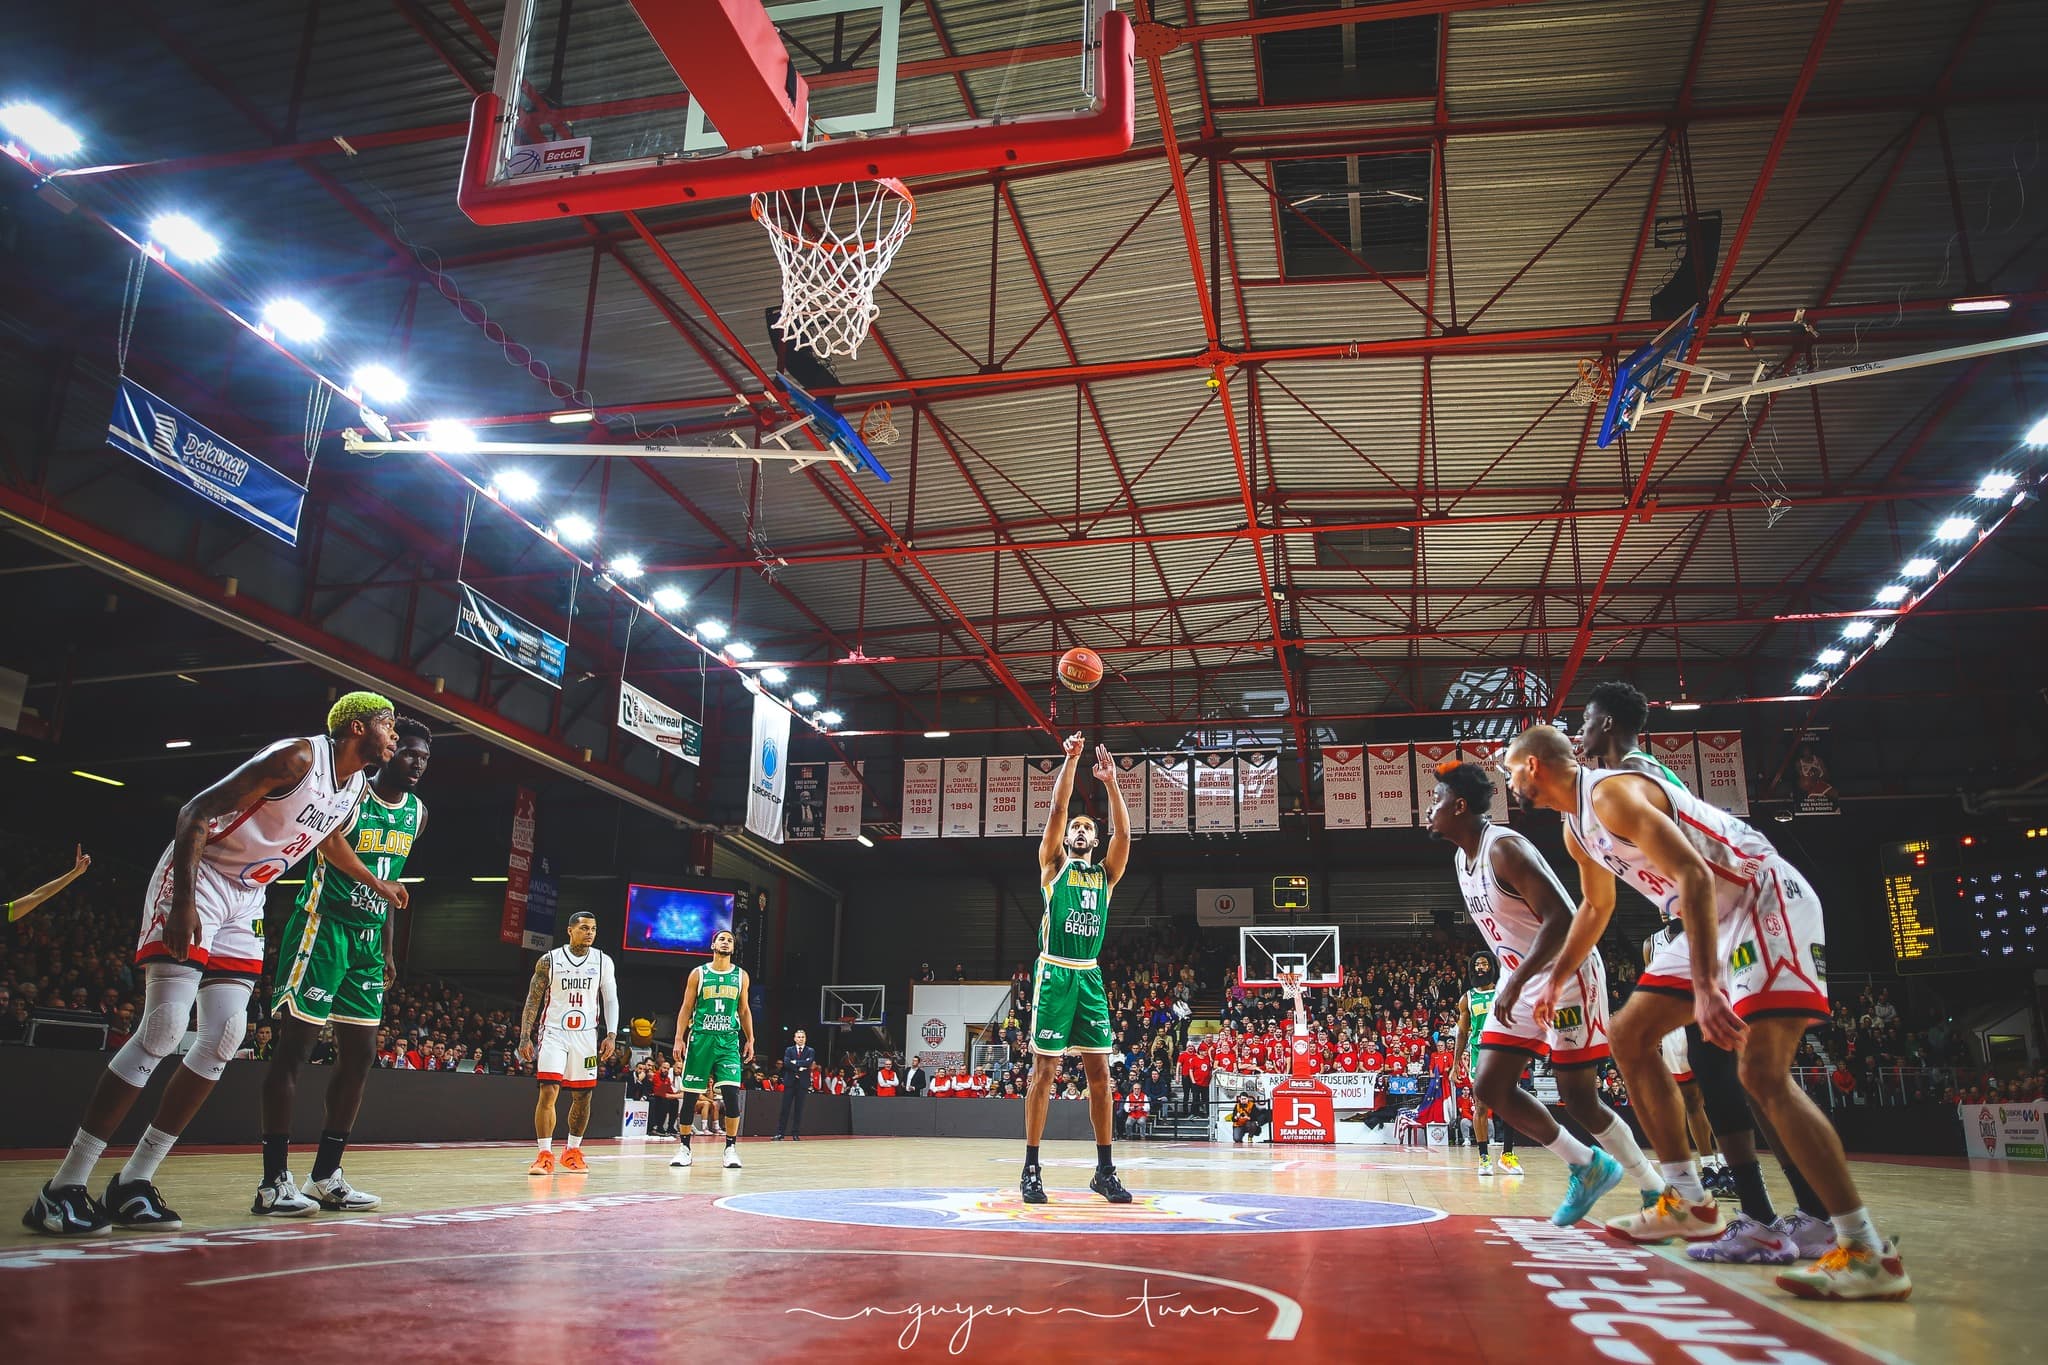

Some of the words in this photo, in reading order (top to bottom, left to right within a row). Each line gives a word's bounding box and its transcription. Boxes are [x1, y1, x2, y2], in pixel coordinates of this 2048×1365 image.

[546, 148, 582, 161] Betclic
[183, 433, 249, 487] Delaunay
[1711, 770, 1737, 778] 1988
[1711, 779, 1737, 787] 2011
[1378, 791, 1403, 799] 1998
[993, 804, 1016, 812] 2008
[1034, 801, 1051, 809] 200
[295, 803, 339, 834] CHOLET
[281, 833, 313, 858] 24
[355, 829, 414, 858] BLOIS
[376, 856, 391, 880] 11
[1783, 879, 1803, 899] 34
[1219, 900, 1231, 910] U
[1481, 917, 1503, 942] 12
[561, 977, 593, 990] CHOLET
[568, 992, 583, 1007] 44
[714, 999, 725, 1013] 14
[921, 1026, 947, 1038] CHOLET
[1318, 1075, 1359, 1085] FFUSEURS
[1280, 1128, 1298, 1136] JEAN
[1299, 1128, 1327, 1136] ROUYER
